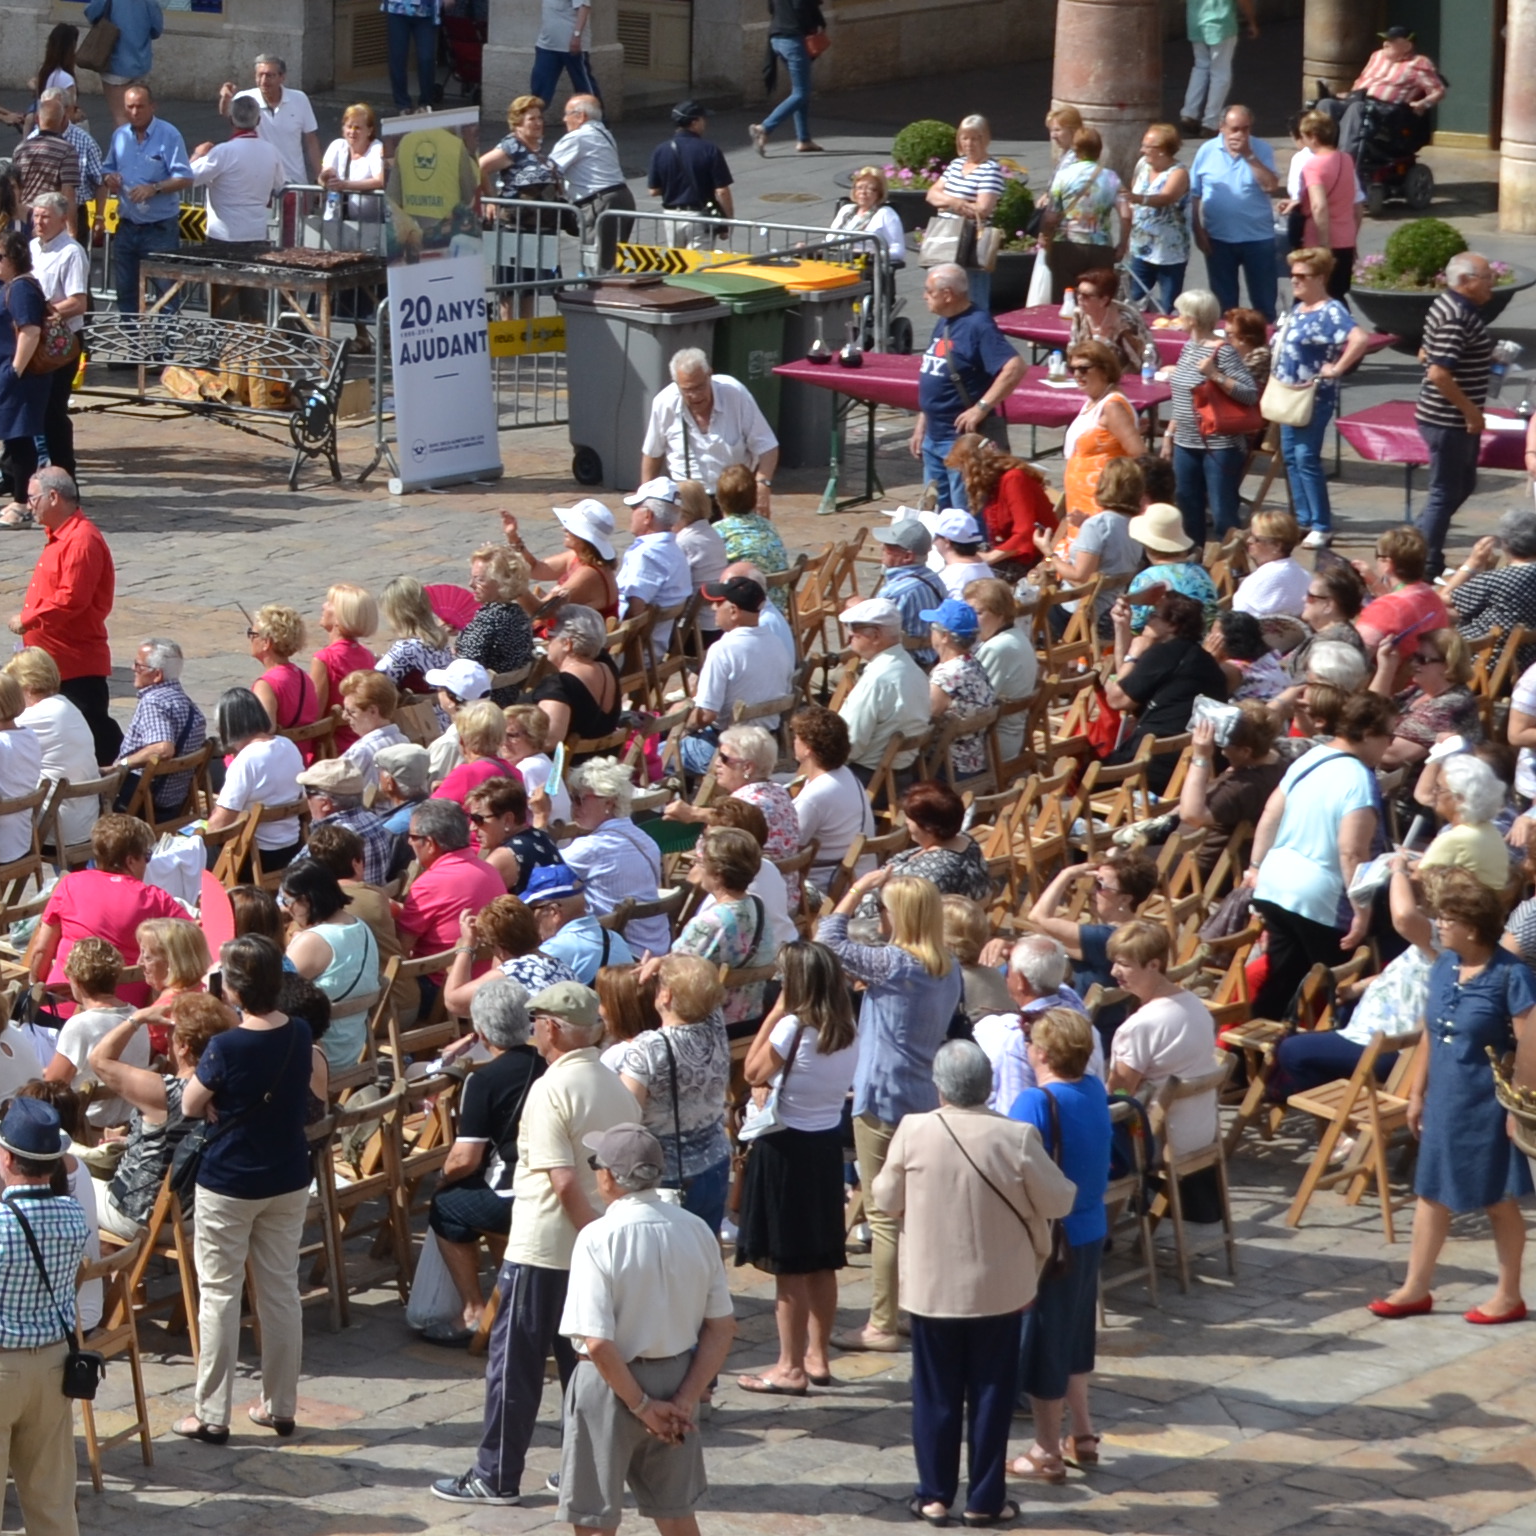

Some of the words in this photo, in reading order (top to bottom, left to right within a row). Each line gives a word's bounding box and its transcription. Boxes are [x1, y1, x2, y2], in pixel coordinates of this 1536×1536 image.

[400, 295, 432, 330] 20
[435, 297, 486, 324] ANYS
[399, 330, 488, 366] AJUDANT
